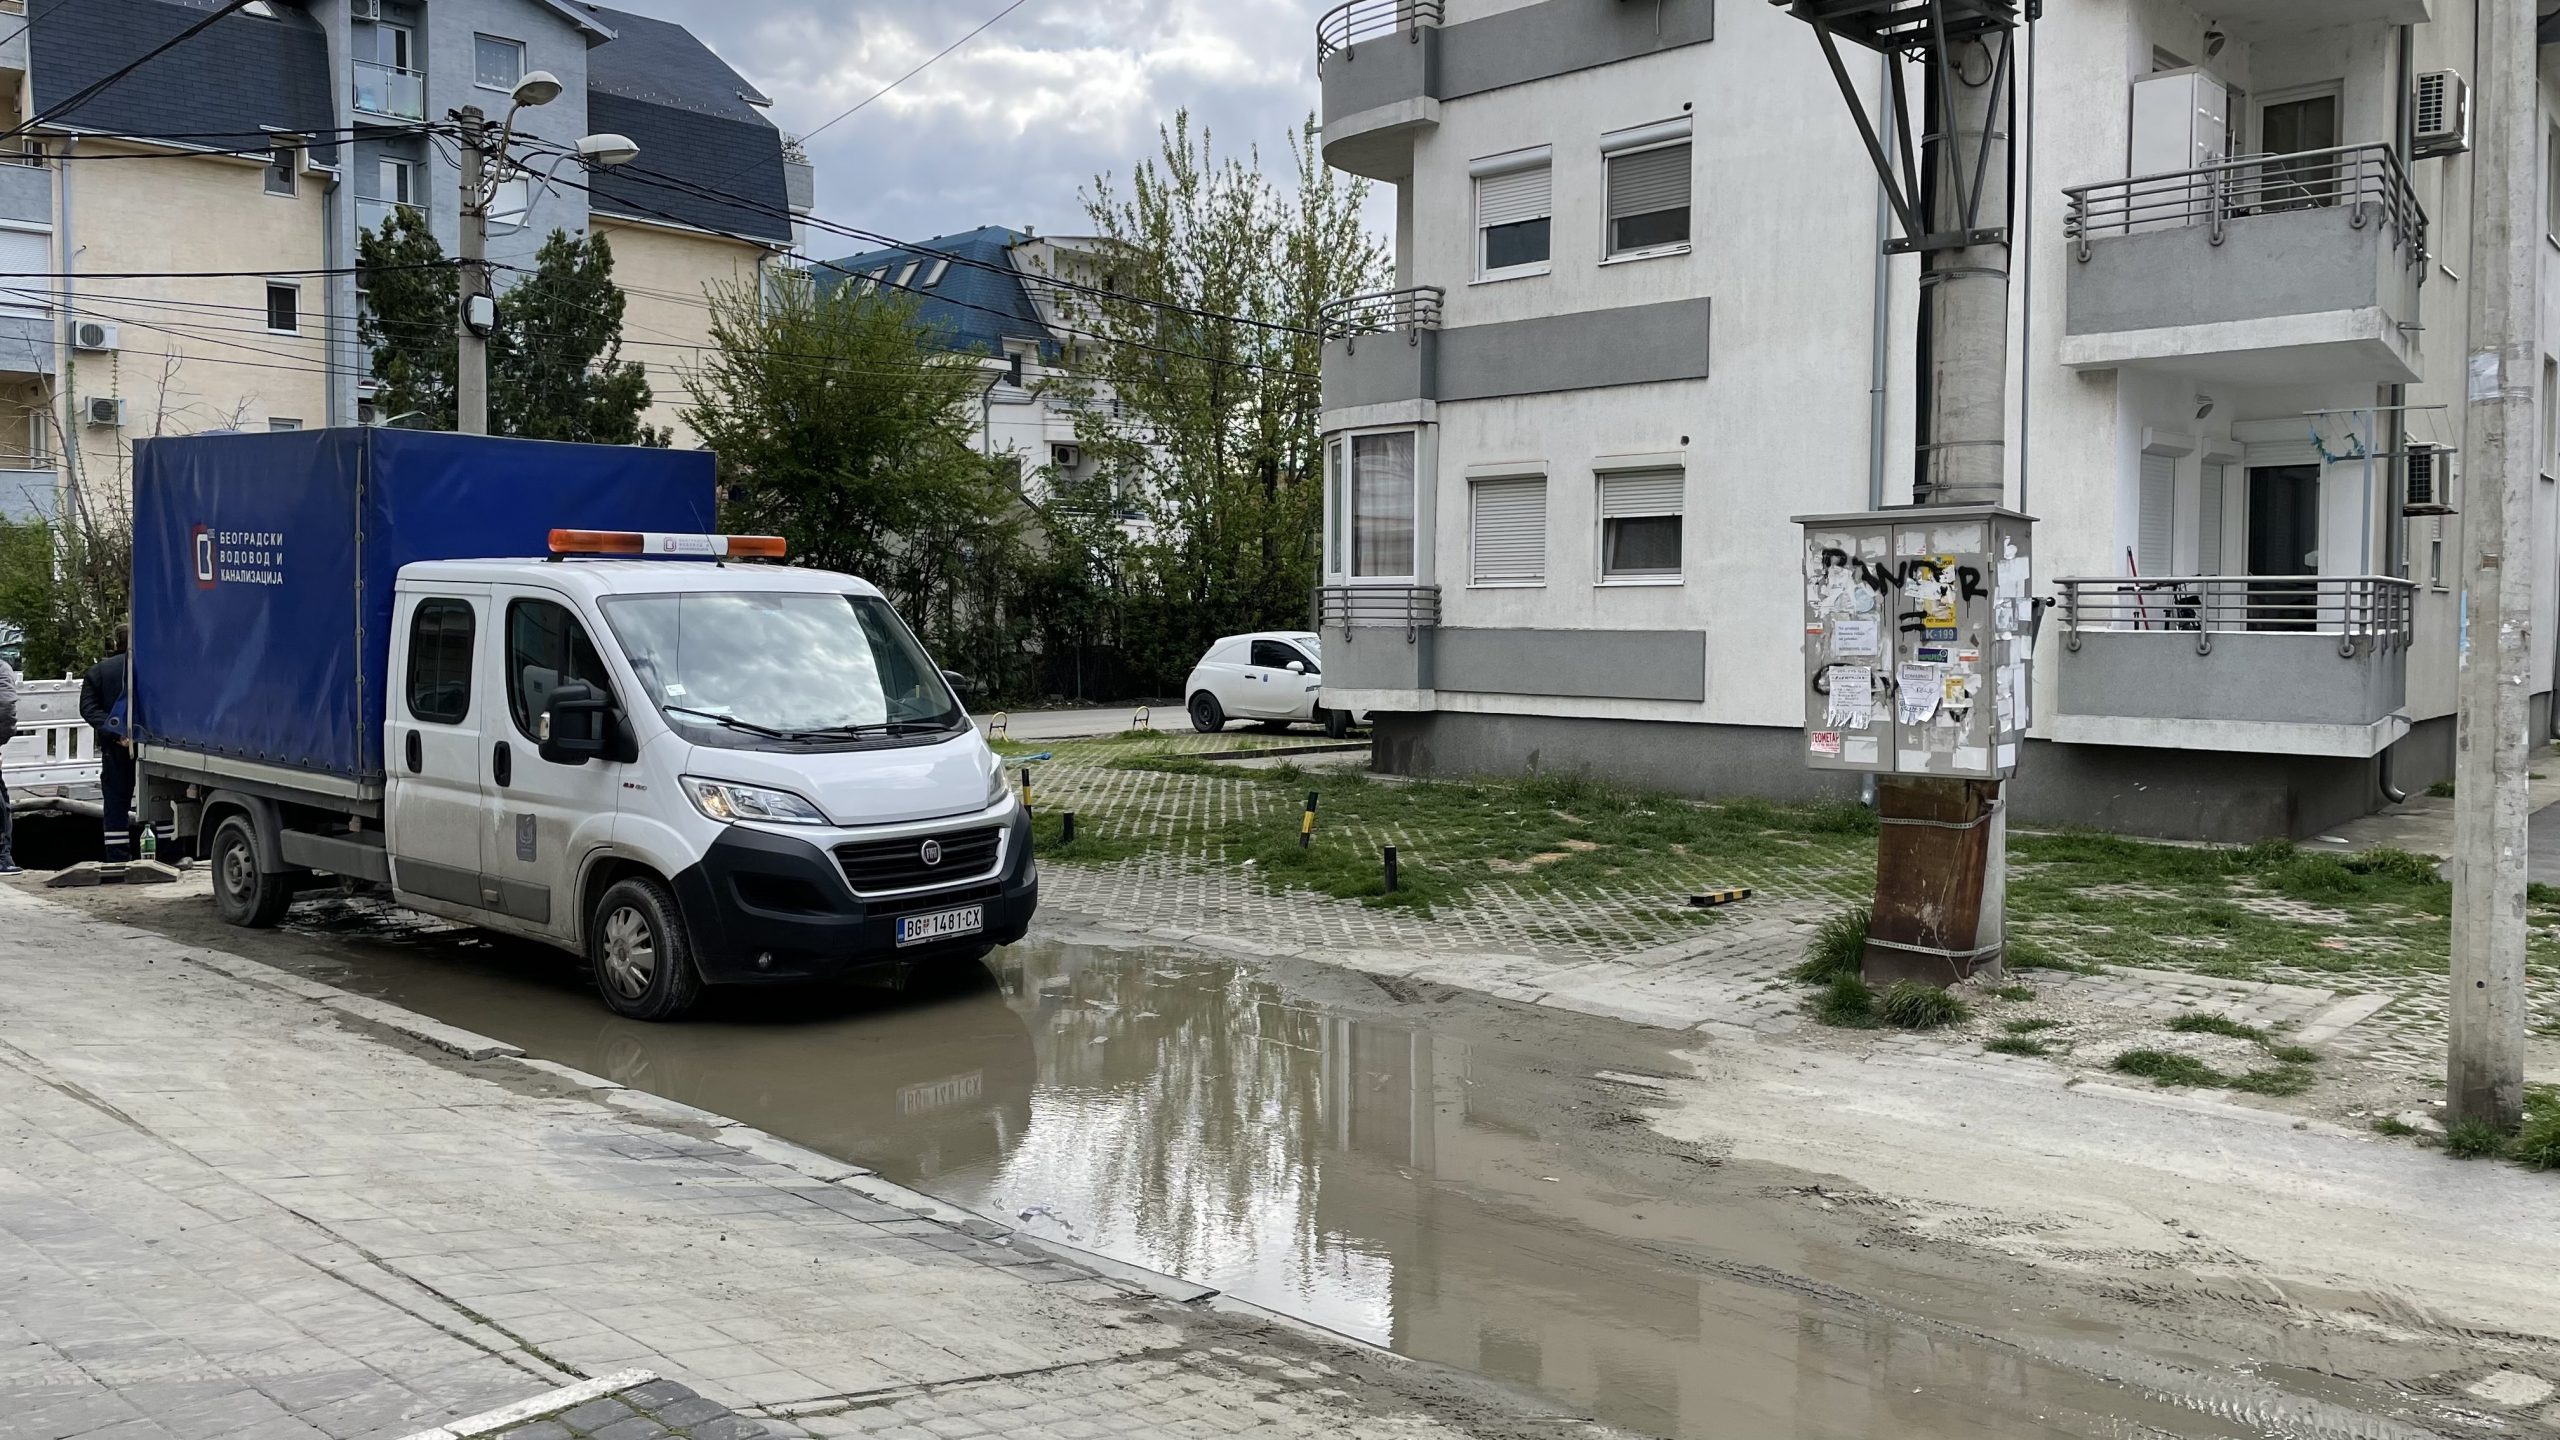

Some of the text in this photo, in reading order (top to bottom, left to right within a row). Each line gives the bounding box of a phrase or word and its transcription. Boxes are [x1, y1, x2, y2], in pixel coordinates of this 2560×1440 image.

[220, 532, 283, 547] БЕОГРАДСКИ
[220, 551, 283, 566] ВОДОВОД И
[221, 569, 283, 585] КАНАЛИЗАЦИЈА
[1926, 629, 1954, 640] K-199
[926, 847, 938, 859] FIAT
[907, 919, 922, 937] BG
